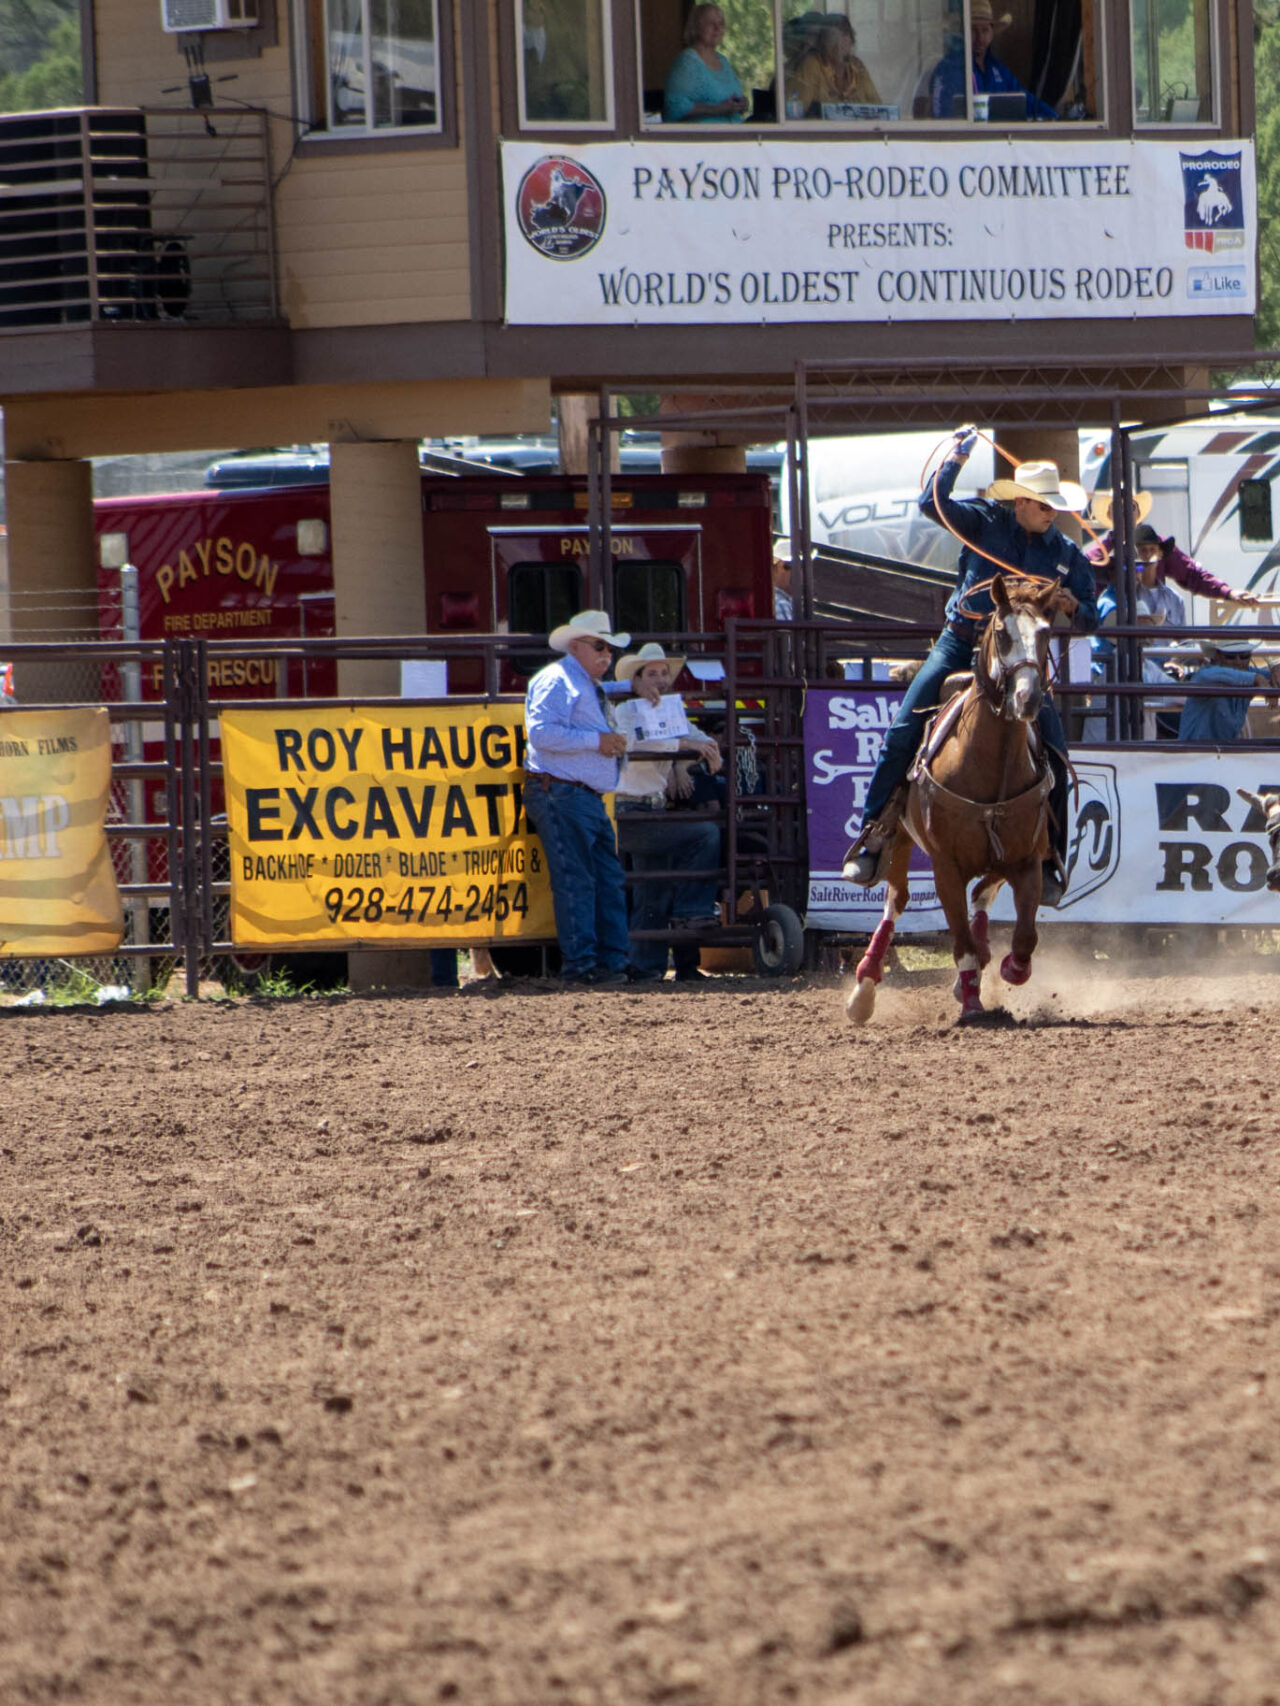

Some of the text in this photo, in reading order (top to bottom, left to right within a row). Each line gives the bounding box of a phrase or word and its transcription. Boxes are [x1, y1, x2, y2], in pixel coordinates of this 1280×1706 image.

[633, 161, 1131, 200] PAYSON PRO-RODEO COMMITTEE
[1182, 160, 1240, 171] PRORODEO
[827, 222, 953, 248] PRESENTS:
[599, 265, 1174, 306] WORLD'S OLDEST CONTINUOUS RODEO
[1214, 277, 1241, 292] Like
[561, 536, 634, 555] PAYON
[155, 537, 279, 604] PAYSON
[164, 609, 273, 632] FIRE DEPARTMENT
[207, 659, 279, 687] RESCU
[37, 736, 78, 756] FILMS
[274, 728, 364, 772] ROY
[0, 793, 70, 861] MP
[243, 847, 541, 881] BACKHOE DOZER BLADE TRUCKING &
[325, 882, 528, 924] 928-474-2454
